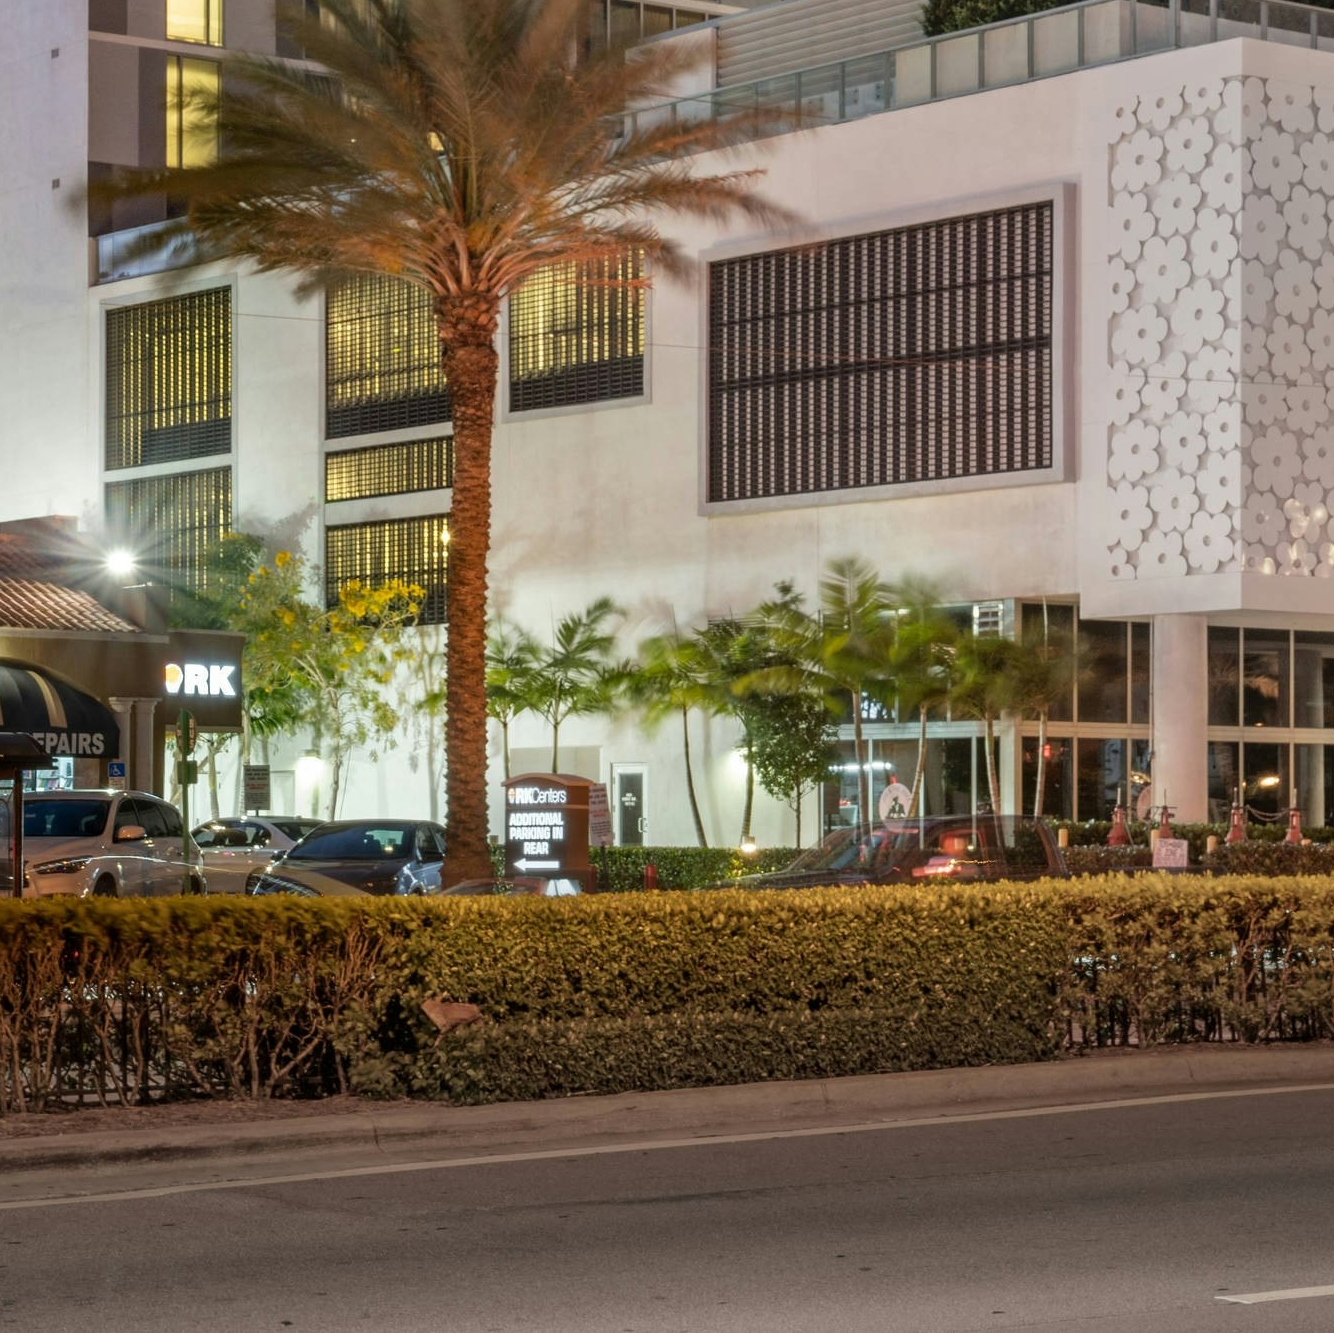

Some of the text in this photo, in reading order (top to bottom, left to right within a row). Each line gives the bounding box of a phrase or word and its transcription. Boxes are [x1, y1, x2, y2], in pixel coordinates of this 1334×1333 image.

[183, 663, 236, 696] RK
[31, 732, 105, 755] EPAIRS
[509, 812, 564, 826] ADDITIONAL
[509, 826, 564, 840] PARKING IN
[523, 841, 549, 855] REAR
